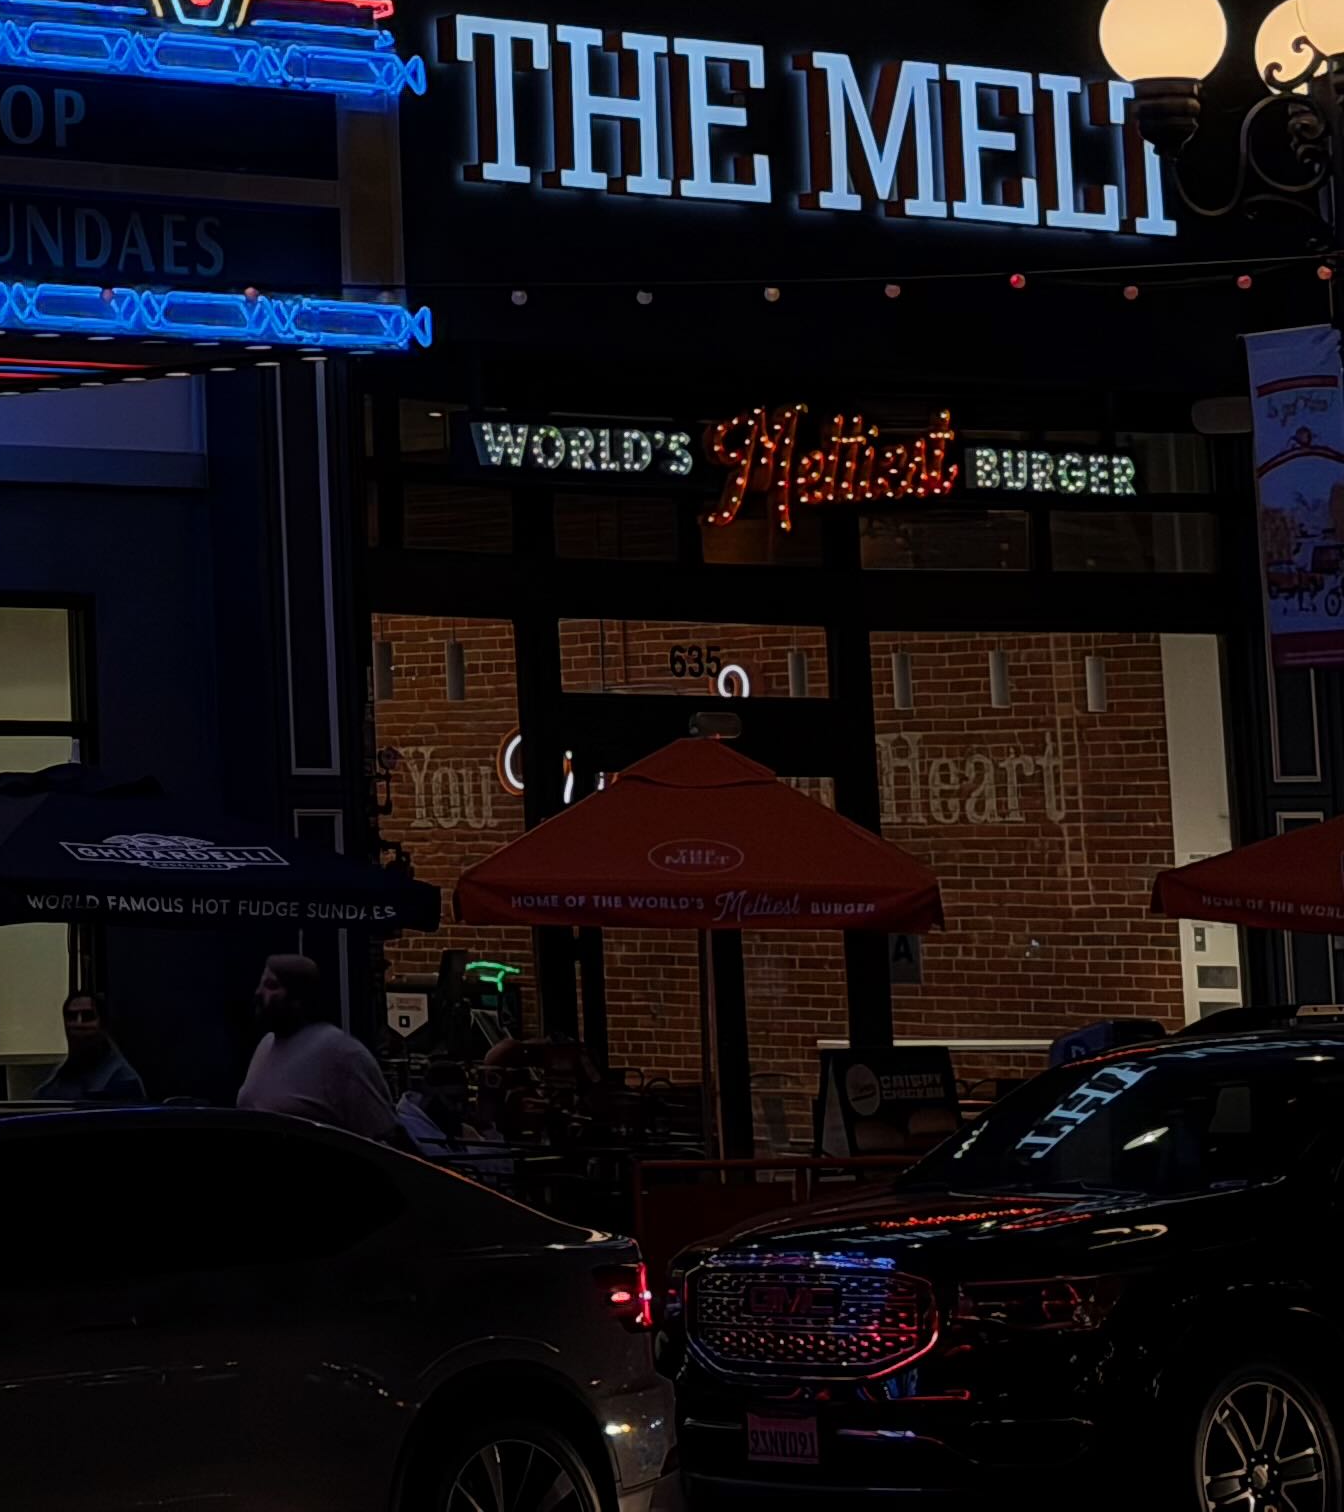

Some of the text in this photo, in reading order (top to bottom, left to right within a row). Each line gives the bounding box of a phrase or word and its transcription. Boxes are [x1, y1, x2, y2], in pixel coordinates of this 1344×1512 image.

[442, 13, 1178, 236] THE MELT
[472, 421, 693, 475] WORLD'S
[973, 447, 1137, 496] BURGER
[669, 644, 722, 678] 635
[875, 731, 1065, 824] Heart
[26, 894, 100, 911] WORLD
[107, 895, 184, 914] FAMOUS
[191, 898, 231, 917] HOT
[238, 900, 300, 919] FUDGE
[511, 894, 561, 909] HOME
[565, 895, 588, 908] OF
[593, 895, 624, 909] THE
[628, 895, 705, 910] WORLD'S
[811, 901, 878, 915] BURGER
[893, 935, 912, 962] A
